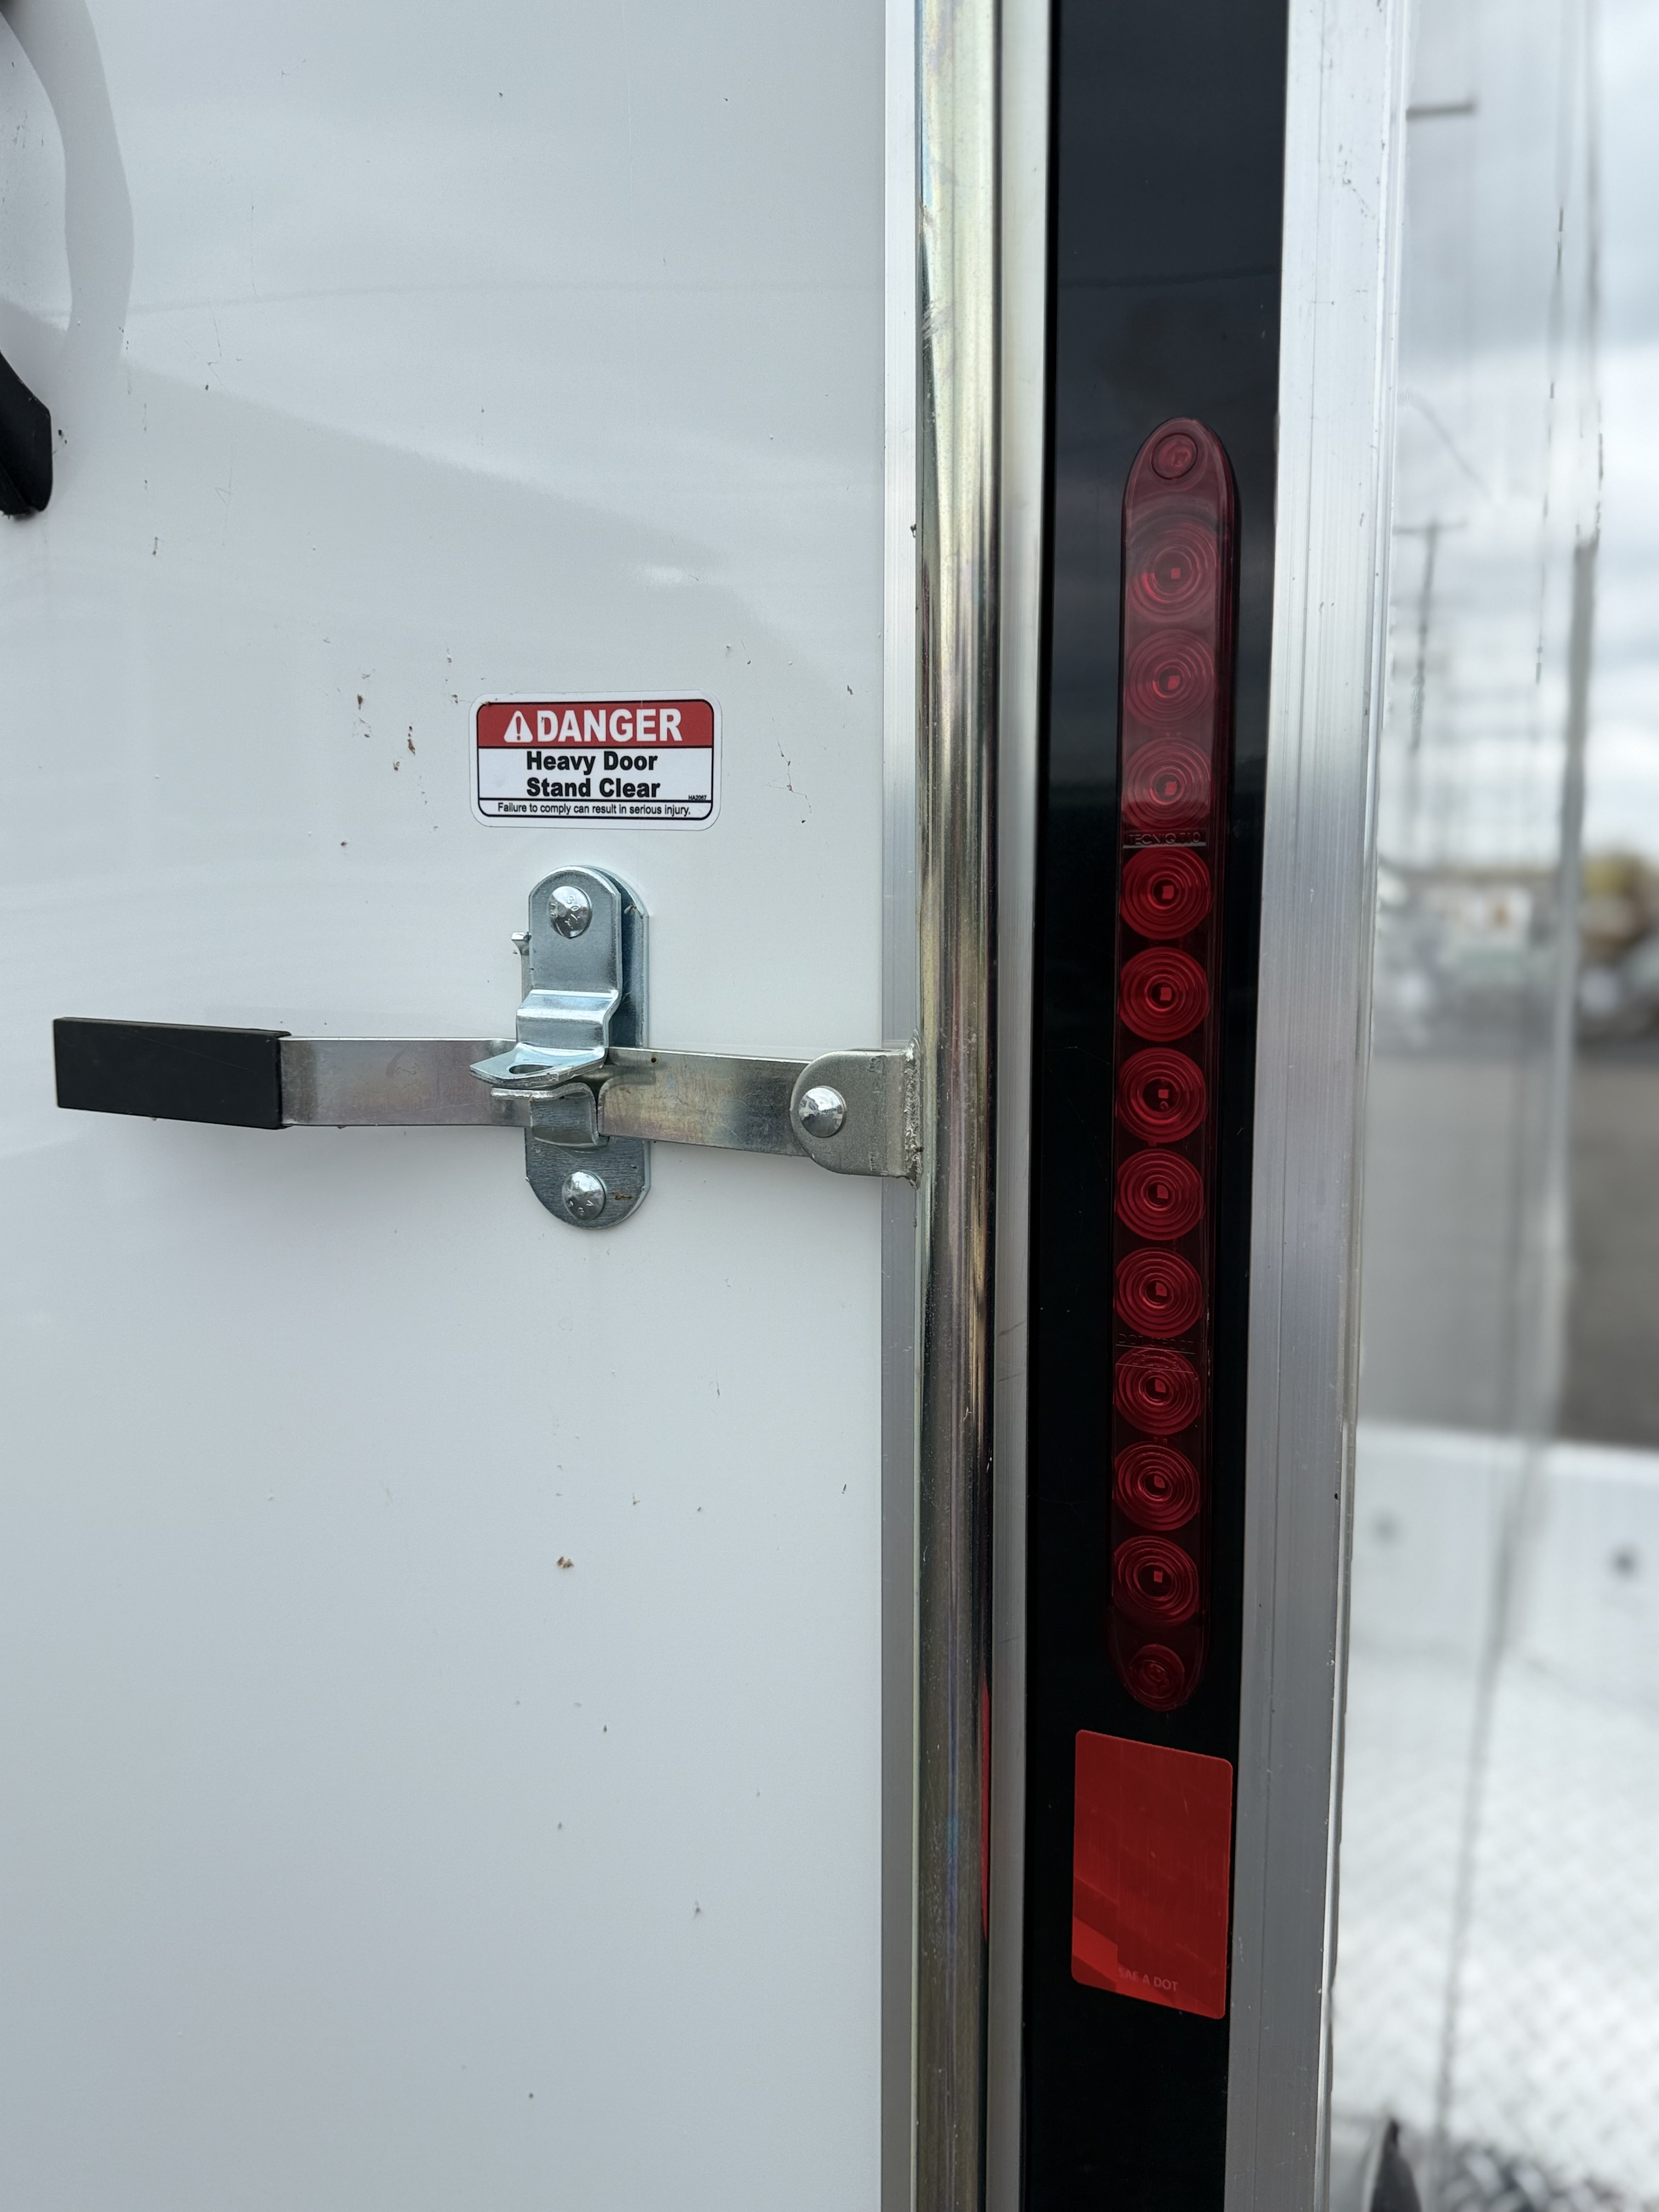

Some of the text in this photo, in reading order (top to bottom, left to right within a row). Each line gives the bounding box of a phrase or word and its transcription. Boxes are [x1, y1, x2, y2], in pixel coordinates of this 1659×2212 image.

[537, 708, 682, 742] DANGER
[527, 751, 658, 775] Heavy Door
[527, 777, 661, 798] Stand Clear
[498, 803, 527, 812] Failure
[529, 803, 538, 812] to
[540, 803, 571, 815] comply
[592, 804, 617, 814] result
[619, 804, 627, 814] in
[629, 804, 662, 814] serious
[664, 804, 691, 817] injury.
[1128, 832, 1176, 845] TECNIQ
[1118, 1967, 1178, 1991] SAE A DOT
